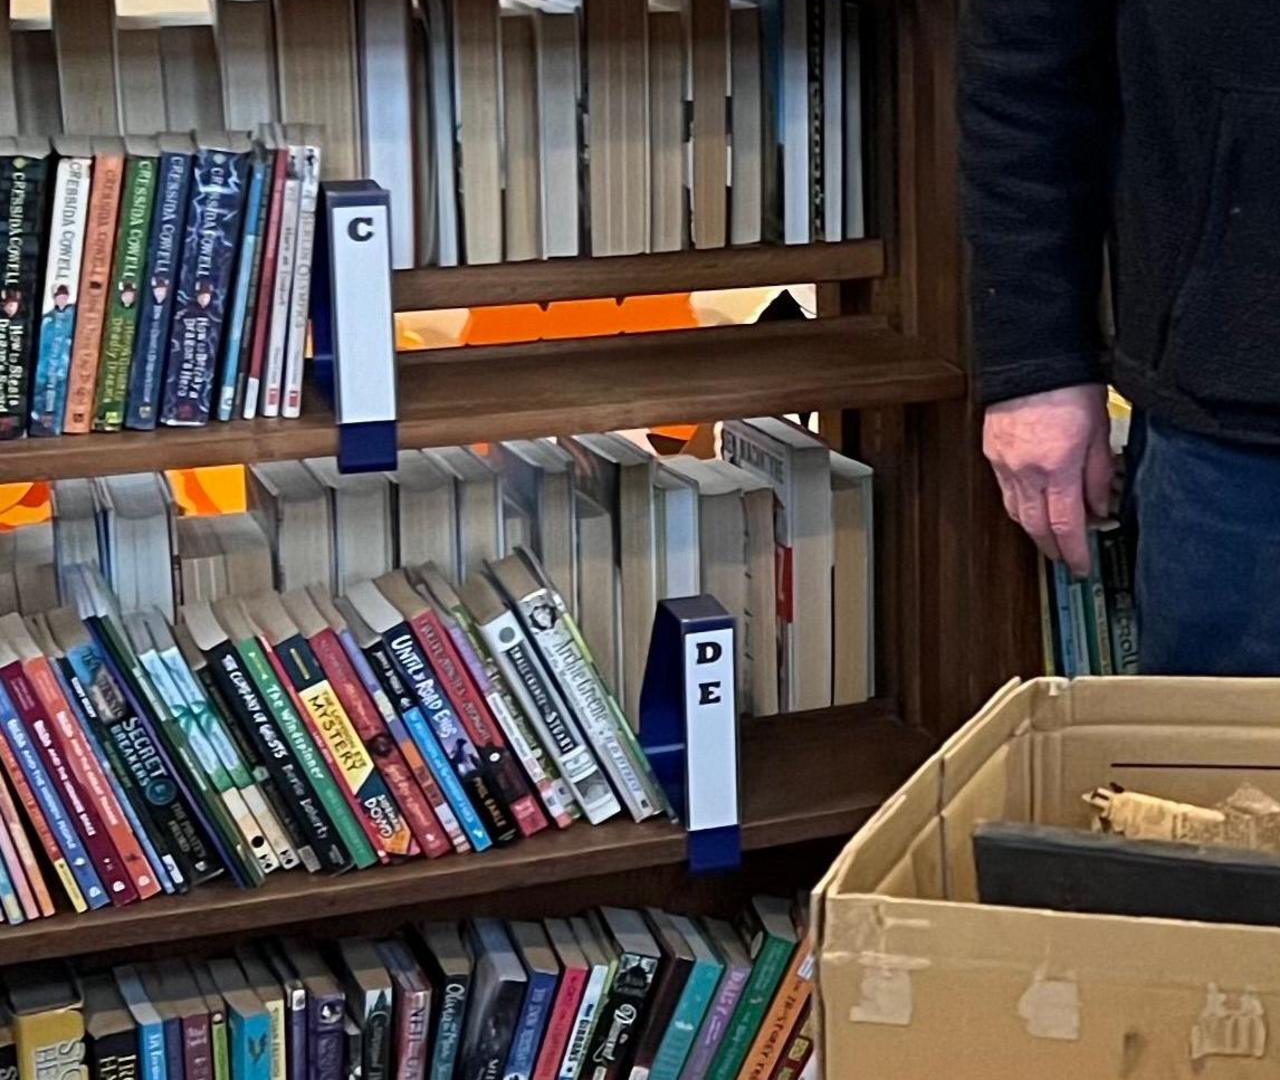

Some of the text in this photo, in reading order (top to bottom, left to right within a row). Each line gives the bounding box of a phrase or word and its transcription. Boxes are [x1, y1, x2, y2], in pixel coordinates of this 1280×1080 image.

[3, 171, 25, 285] CRESSIDA COWELL
[54, 161, 82, 281] CRESSIDA COWELL
[90, 169, 115, 276] CRESSIDA COWELL
[120, 160, 150, 279] CRESSIDA COWELL
[153, 156, 183, 274] CRESSIDA COWELL
[347, 217, 375, 242] C
[195, 229, 217, 278] COWELL
[9, 325, 24, 351] How
[105, 317, 124, 358] Deadly
[176, 317, 200, 397] Dragon's Hero
[193, 317, 208, 341] How
[7, 365, 23, 399] Steal
[190, 352, 207, 389] Betray
[391, 634, 425, 674] UNTIL
[415, 678, 445, 712] ROAD
[553, 637, 590, 682] Archie
[576, 677, 611, 723] Greene
[696, 641, 723, 665] D
[509, 646, 530, 674] SMALL
[544, 711, 574, 751] STUART
[698, 681, 722, 706] E
[110, 723, 151, 786] BREAKERS
[121, 714, 168, 780] SECRET
[264, 684, 326, 781] The Windspinner
[307, 695, 358, 773] MYSTERY
[56, 819, 75, 850] PEOPLE
[363, 797, 394, 839] DOWD
